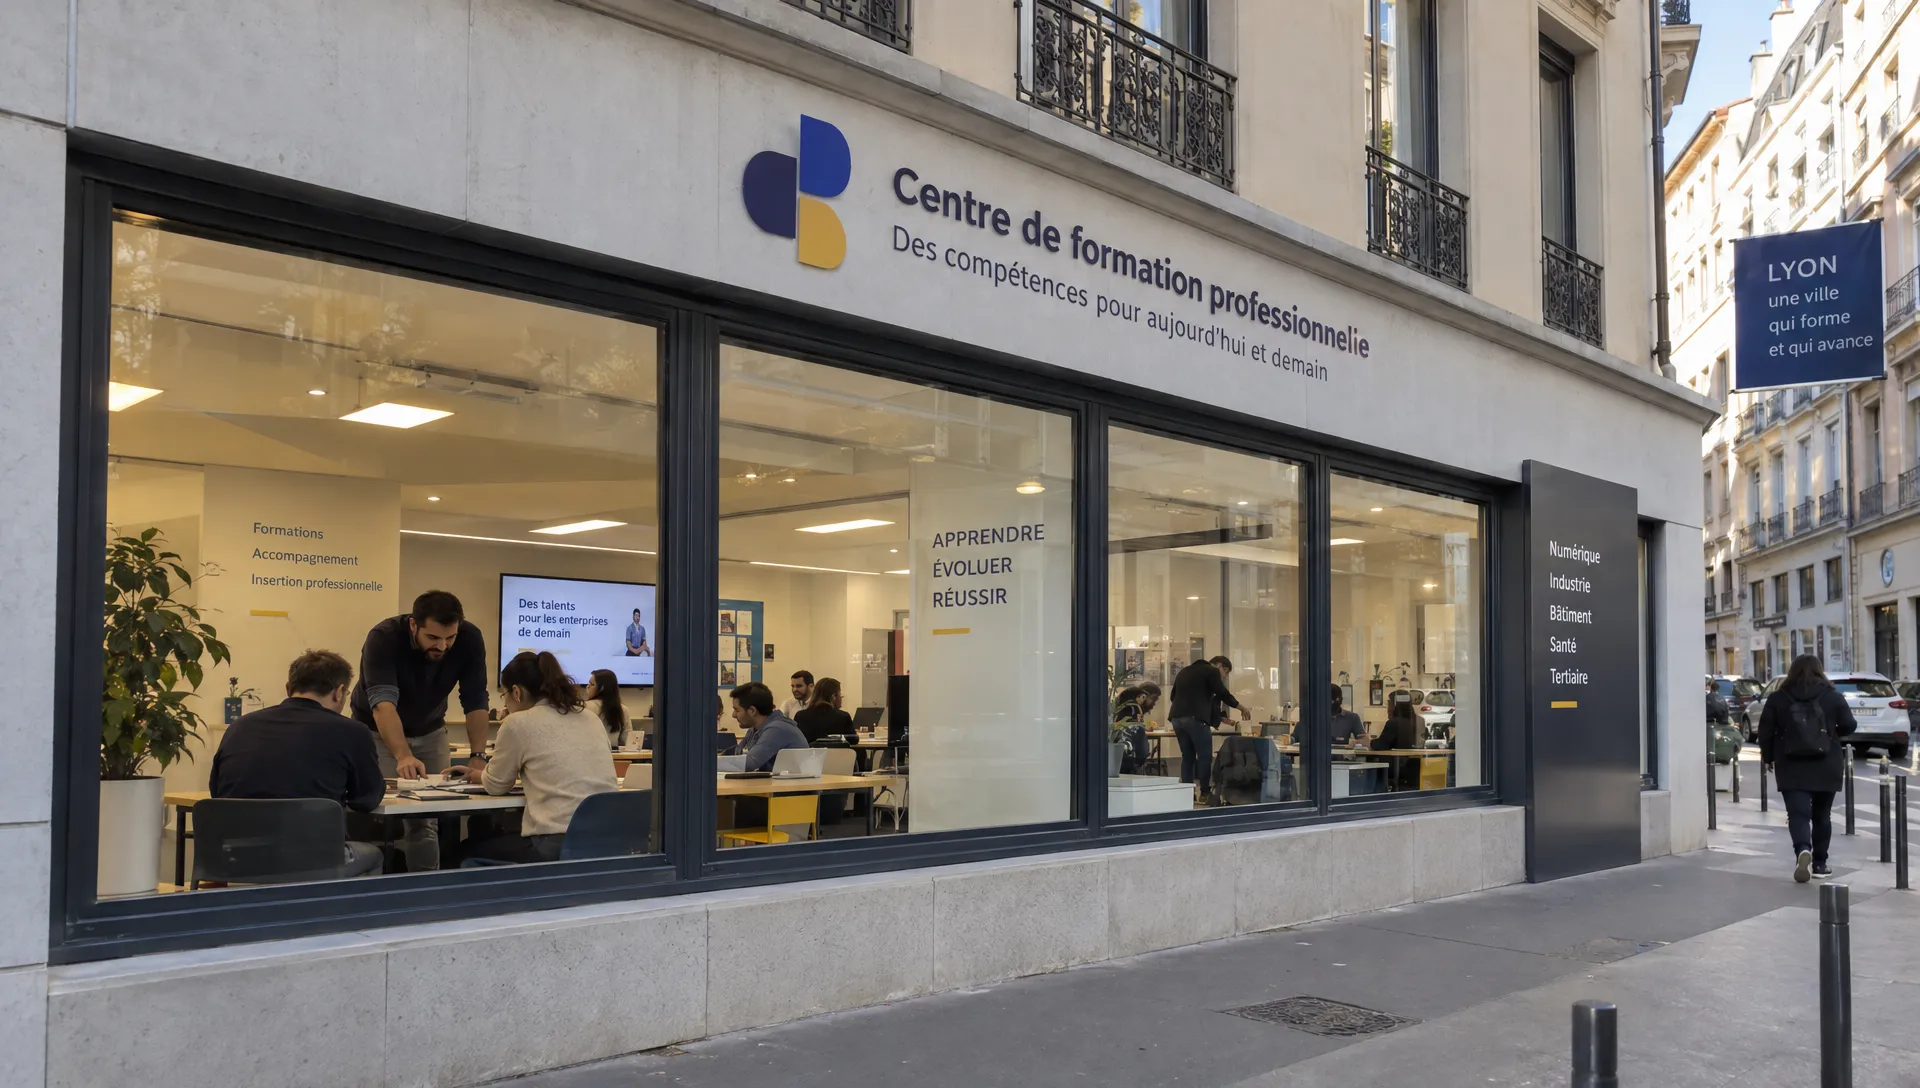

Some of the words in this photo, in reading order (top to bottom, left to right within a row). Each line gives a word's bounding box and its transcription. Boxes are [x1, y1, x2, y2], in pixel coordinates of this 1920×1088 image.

[893, 167, 1011, 236] Centre
[1022, 210, 1061, 253] de
[1070, 225, 1203, 302] formation
[1768, 255, 1837, 282] LYON
[893, 224, 937, 261] Des
[944, 247, 1088, 307] compétences
[1097, 294, 1141, 323] pour
[1147, 310, 1246, 357] aujourd'hui
[1251, 344, 1267, 364] et
[1271, 347, 1328, 382] demain
[1768, 294, 1800, 308] une
[1804, 286, 1839, 303] ville
[1768, 316, 1795, 336] qui
[1800, 312, 1851, 329] forme
[1769, 342, 1785, 357] et
[1788, 338, 1813, 358] qui
[1817, 335, 1874, 352] avance
[253, 522, 324, 540] Formations
[932, 524, 1045, 549] APPRENDRE
[252, 548, 359, 566] Accompagnement
[1549, 540, 1601, 566] Numérique
[933, 557, 1013, 578] ÉVOLUER
[251, 573, 303, 588] Insertion
[305, 577, 383, 592] professionnelle
[1549, 572, 1591, 593] Industrie
[519, 598, 538, 609] Des
[541, 600, 576, 611] talents
[933, 587, 1008, 608] RÉUSSIR
[518, 614, 541, 624] pour
[543, 613, 557, 624] les
[559, 615, 609, 627] enterprises
[1550, 604, 1592, 624] Bâtiment
[518, 627, 532, 637] de
[534, 627, 571, 639] demain
[1550, 636, 1577, 653] Santé
[1550, 668, 1588, 684] Tertiaire
